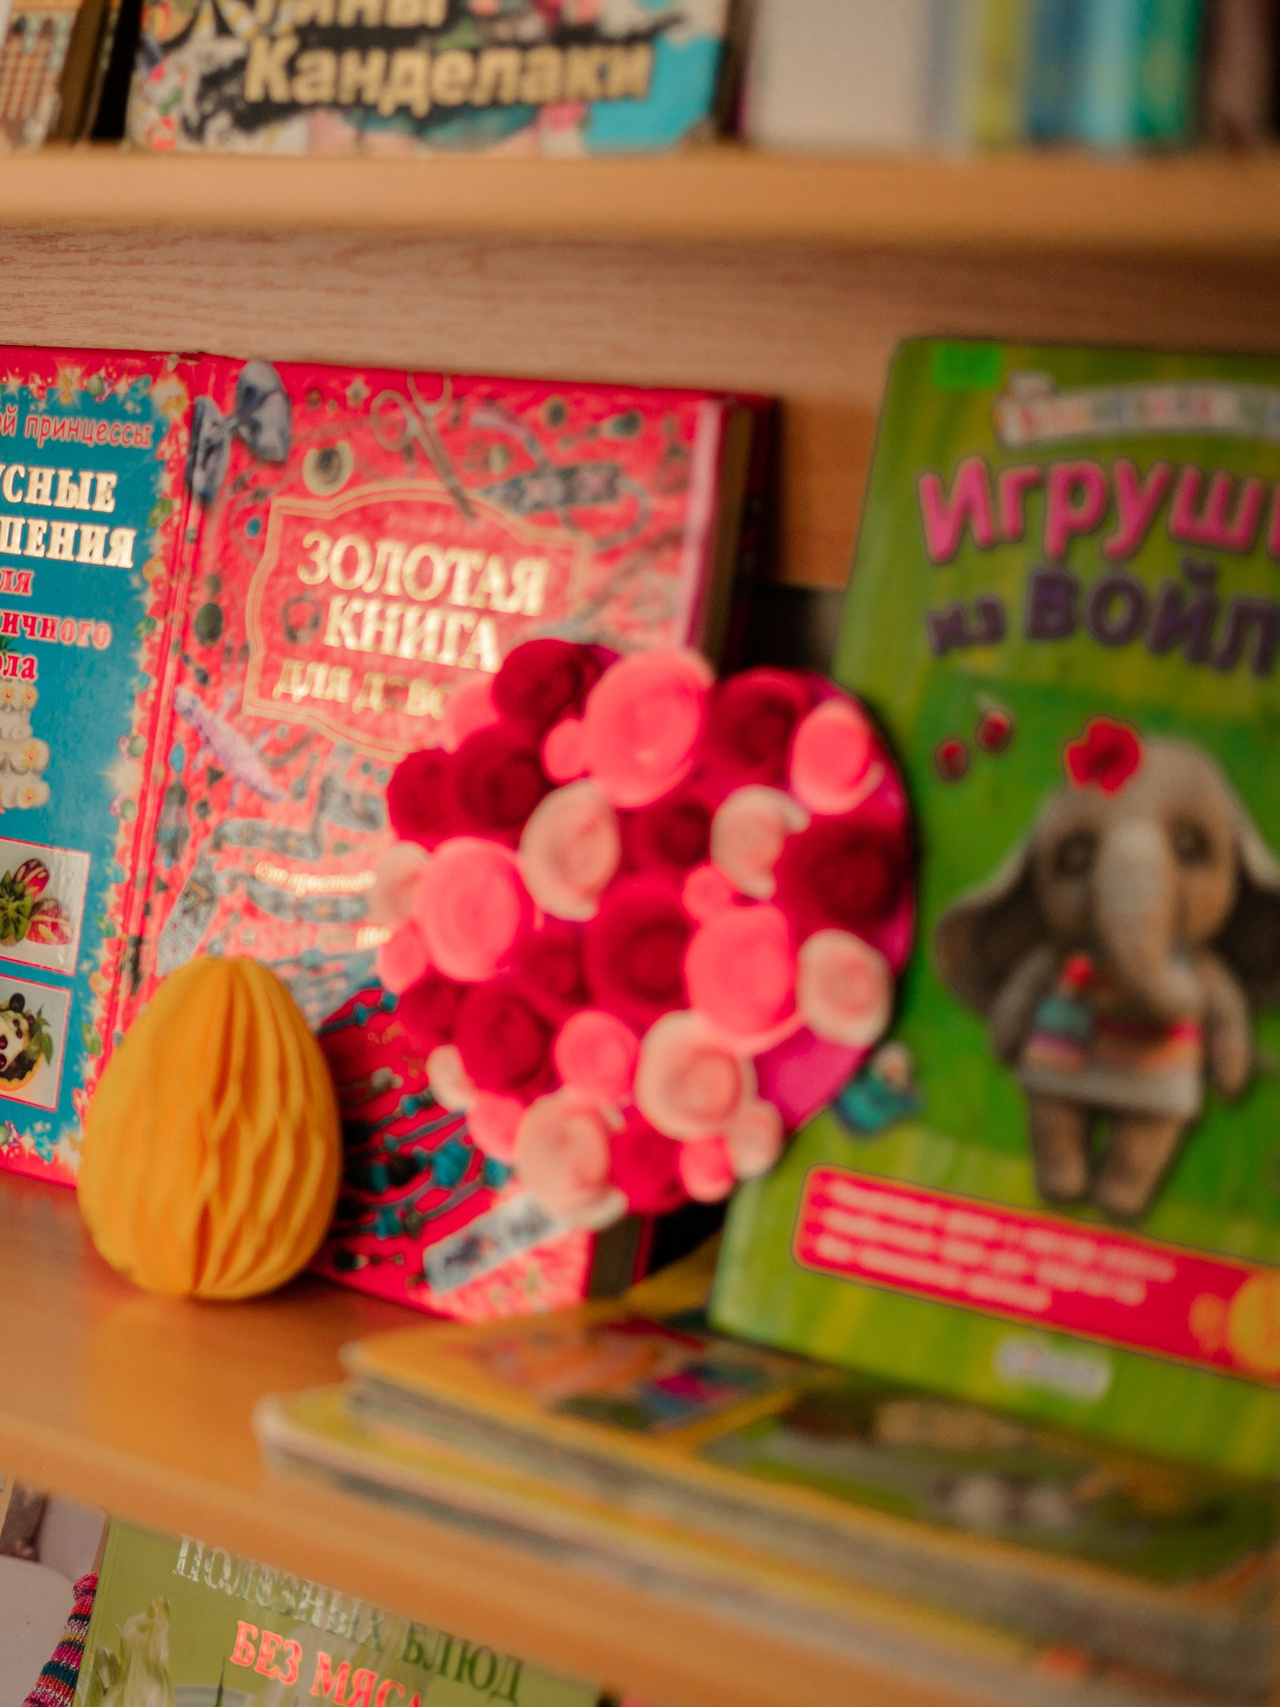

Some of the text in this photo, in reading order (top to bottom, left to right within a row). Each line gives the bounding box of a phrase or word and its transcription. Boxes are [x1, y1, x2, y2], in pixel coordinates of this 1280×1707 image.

[245, 33, 653, 117] Канделаки
[24, 414, 154, 448] принцессы
[296, 531, 550, 617] ЗОЛОТАЯ
[322, 594, 503, 674] КНИГА
[272, 658, 352, 704] ДЛЯ
[172, 1534, 524, 1704] ПОЛЕЗНЫХ БЛЮД
[230, 1619, 422, 1707] БЕЗ МЯС
